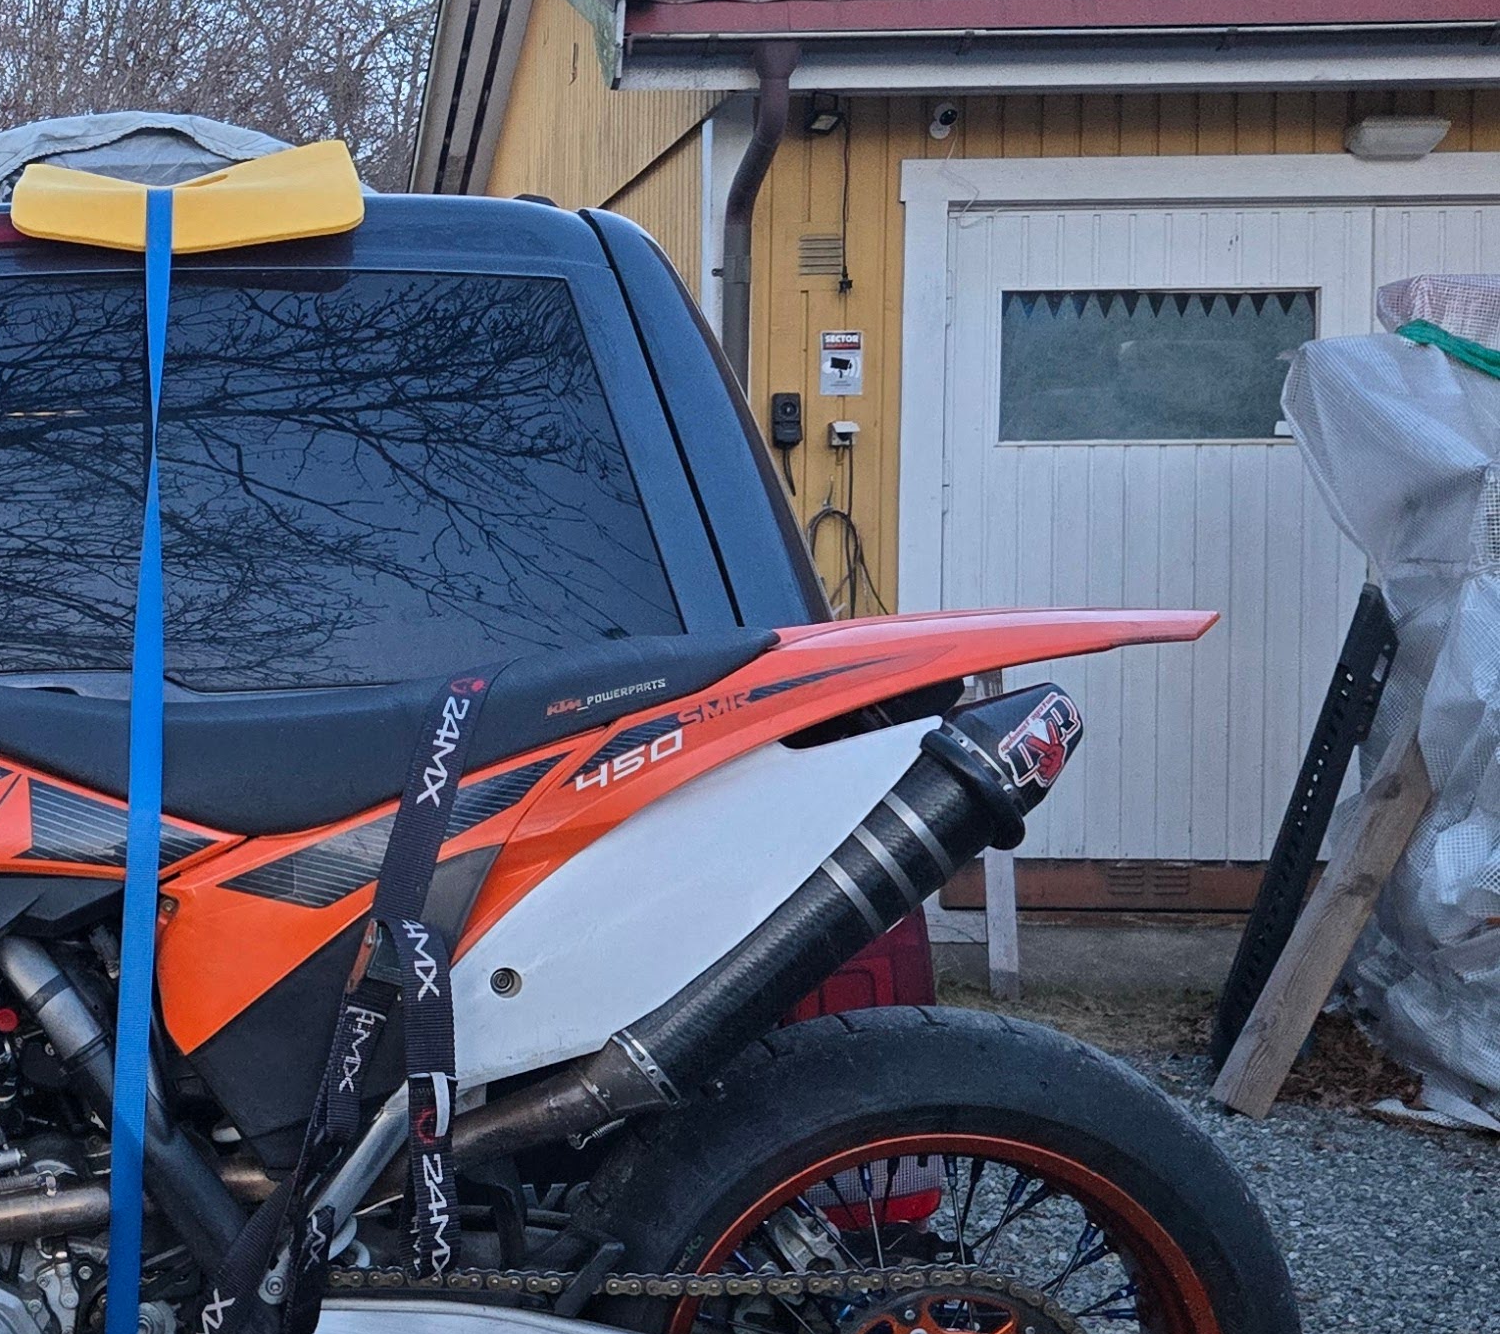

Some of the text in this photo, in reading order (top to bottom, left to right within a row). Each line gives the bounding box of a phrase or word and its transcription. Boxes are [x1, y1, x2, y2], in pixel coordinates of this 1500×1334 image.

[825, 335, 859, 343] SECTOR
[677, 687, 749, 724] SMR
[416, 696, 470, 807] 24MX
[575, 728, 683, 792] 450
